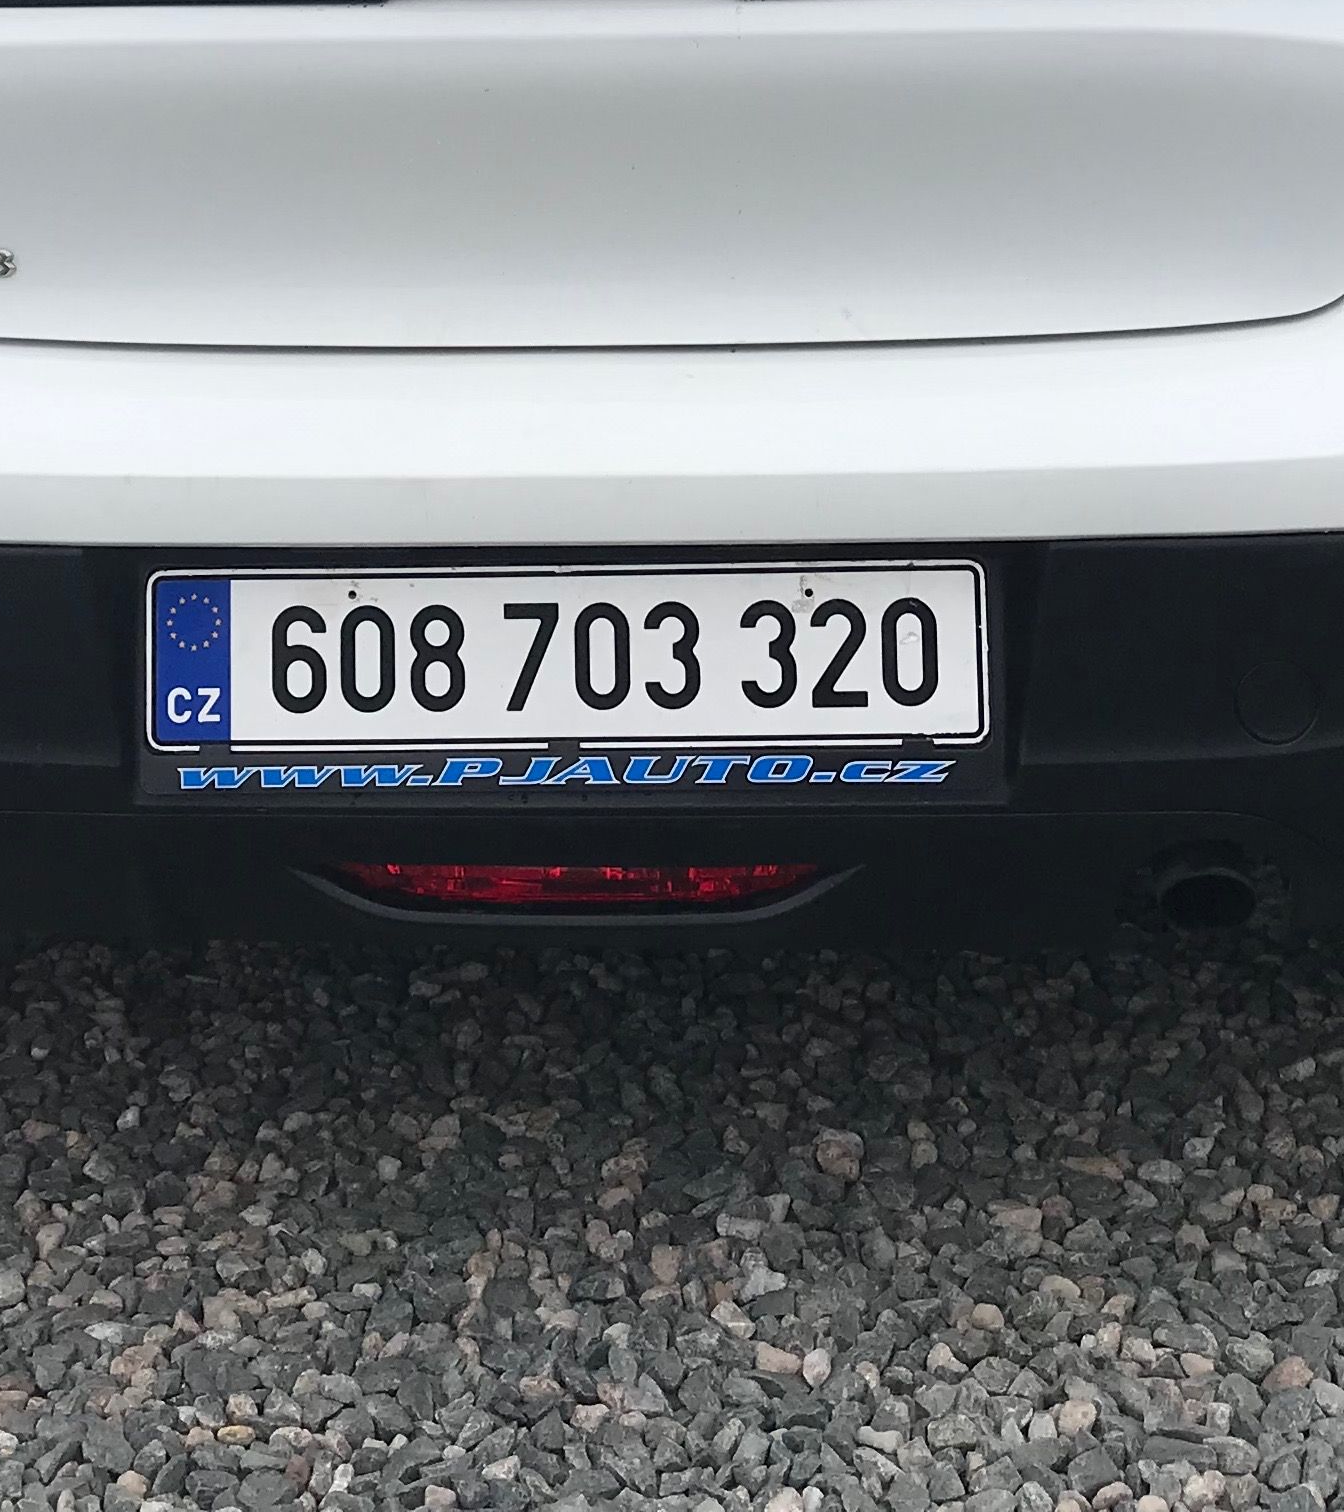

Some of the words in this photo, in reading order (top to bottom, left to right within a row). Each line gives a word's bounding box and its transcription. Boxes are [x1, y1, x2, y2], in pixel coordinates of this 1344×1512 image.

[271, 604, 466, 714] 608
[503, 602, 701, 712] 703
[740, 597, 939, 708] 320
[167, 687, 221, 724] CZ
[177, 755, 956, 790] www.PJAUTO.cz
